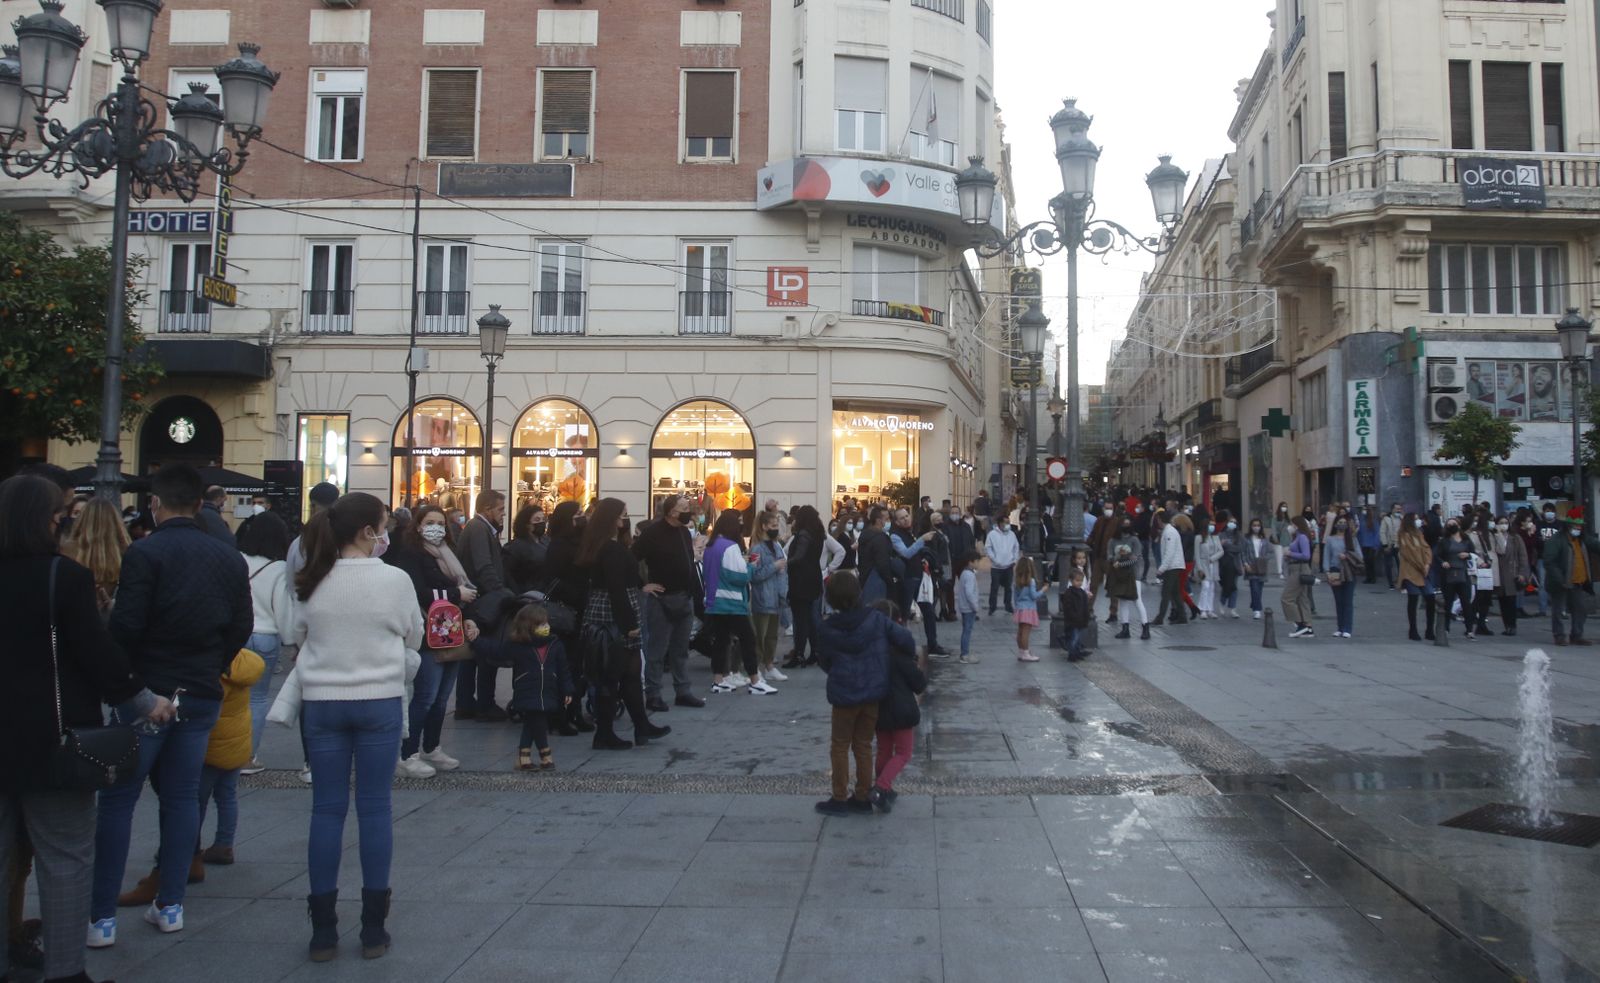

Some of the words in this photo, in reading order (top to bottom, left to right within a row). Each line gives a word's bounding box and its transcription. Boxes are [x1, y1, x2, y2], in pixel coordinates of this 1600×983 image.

[905, 172, 940, 192] Valle
[127, 212, 208, 232] HOTE
[871, 231, 940, 251] ABOGADOS
[203, 277, 237, 306] BOSTON
[851, 416, 886, 429] ALVARO
[899, 420, 934, 431] MORENO
[1353, 381, 1371, 455] FARMACIA
